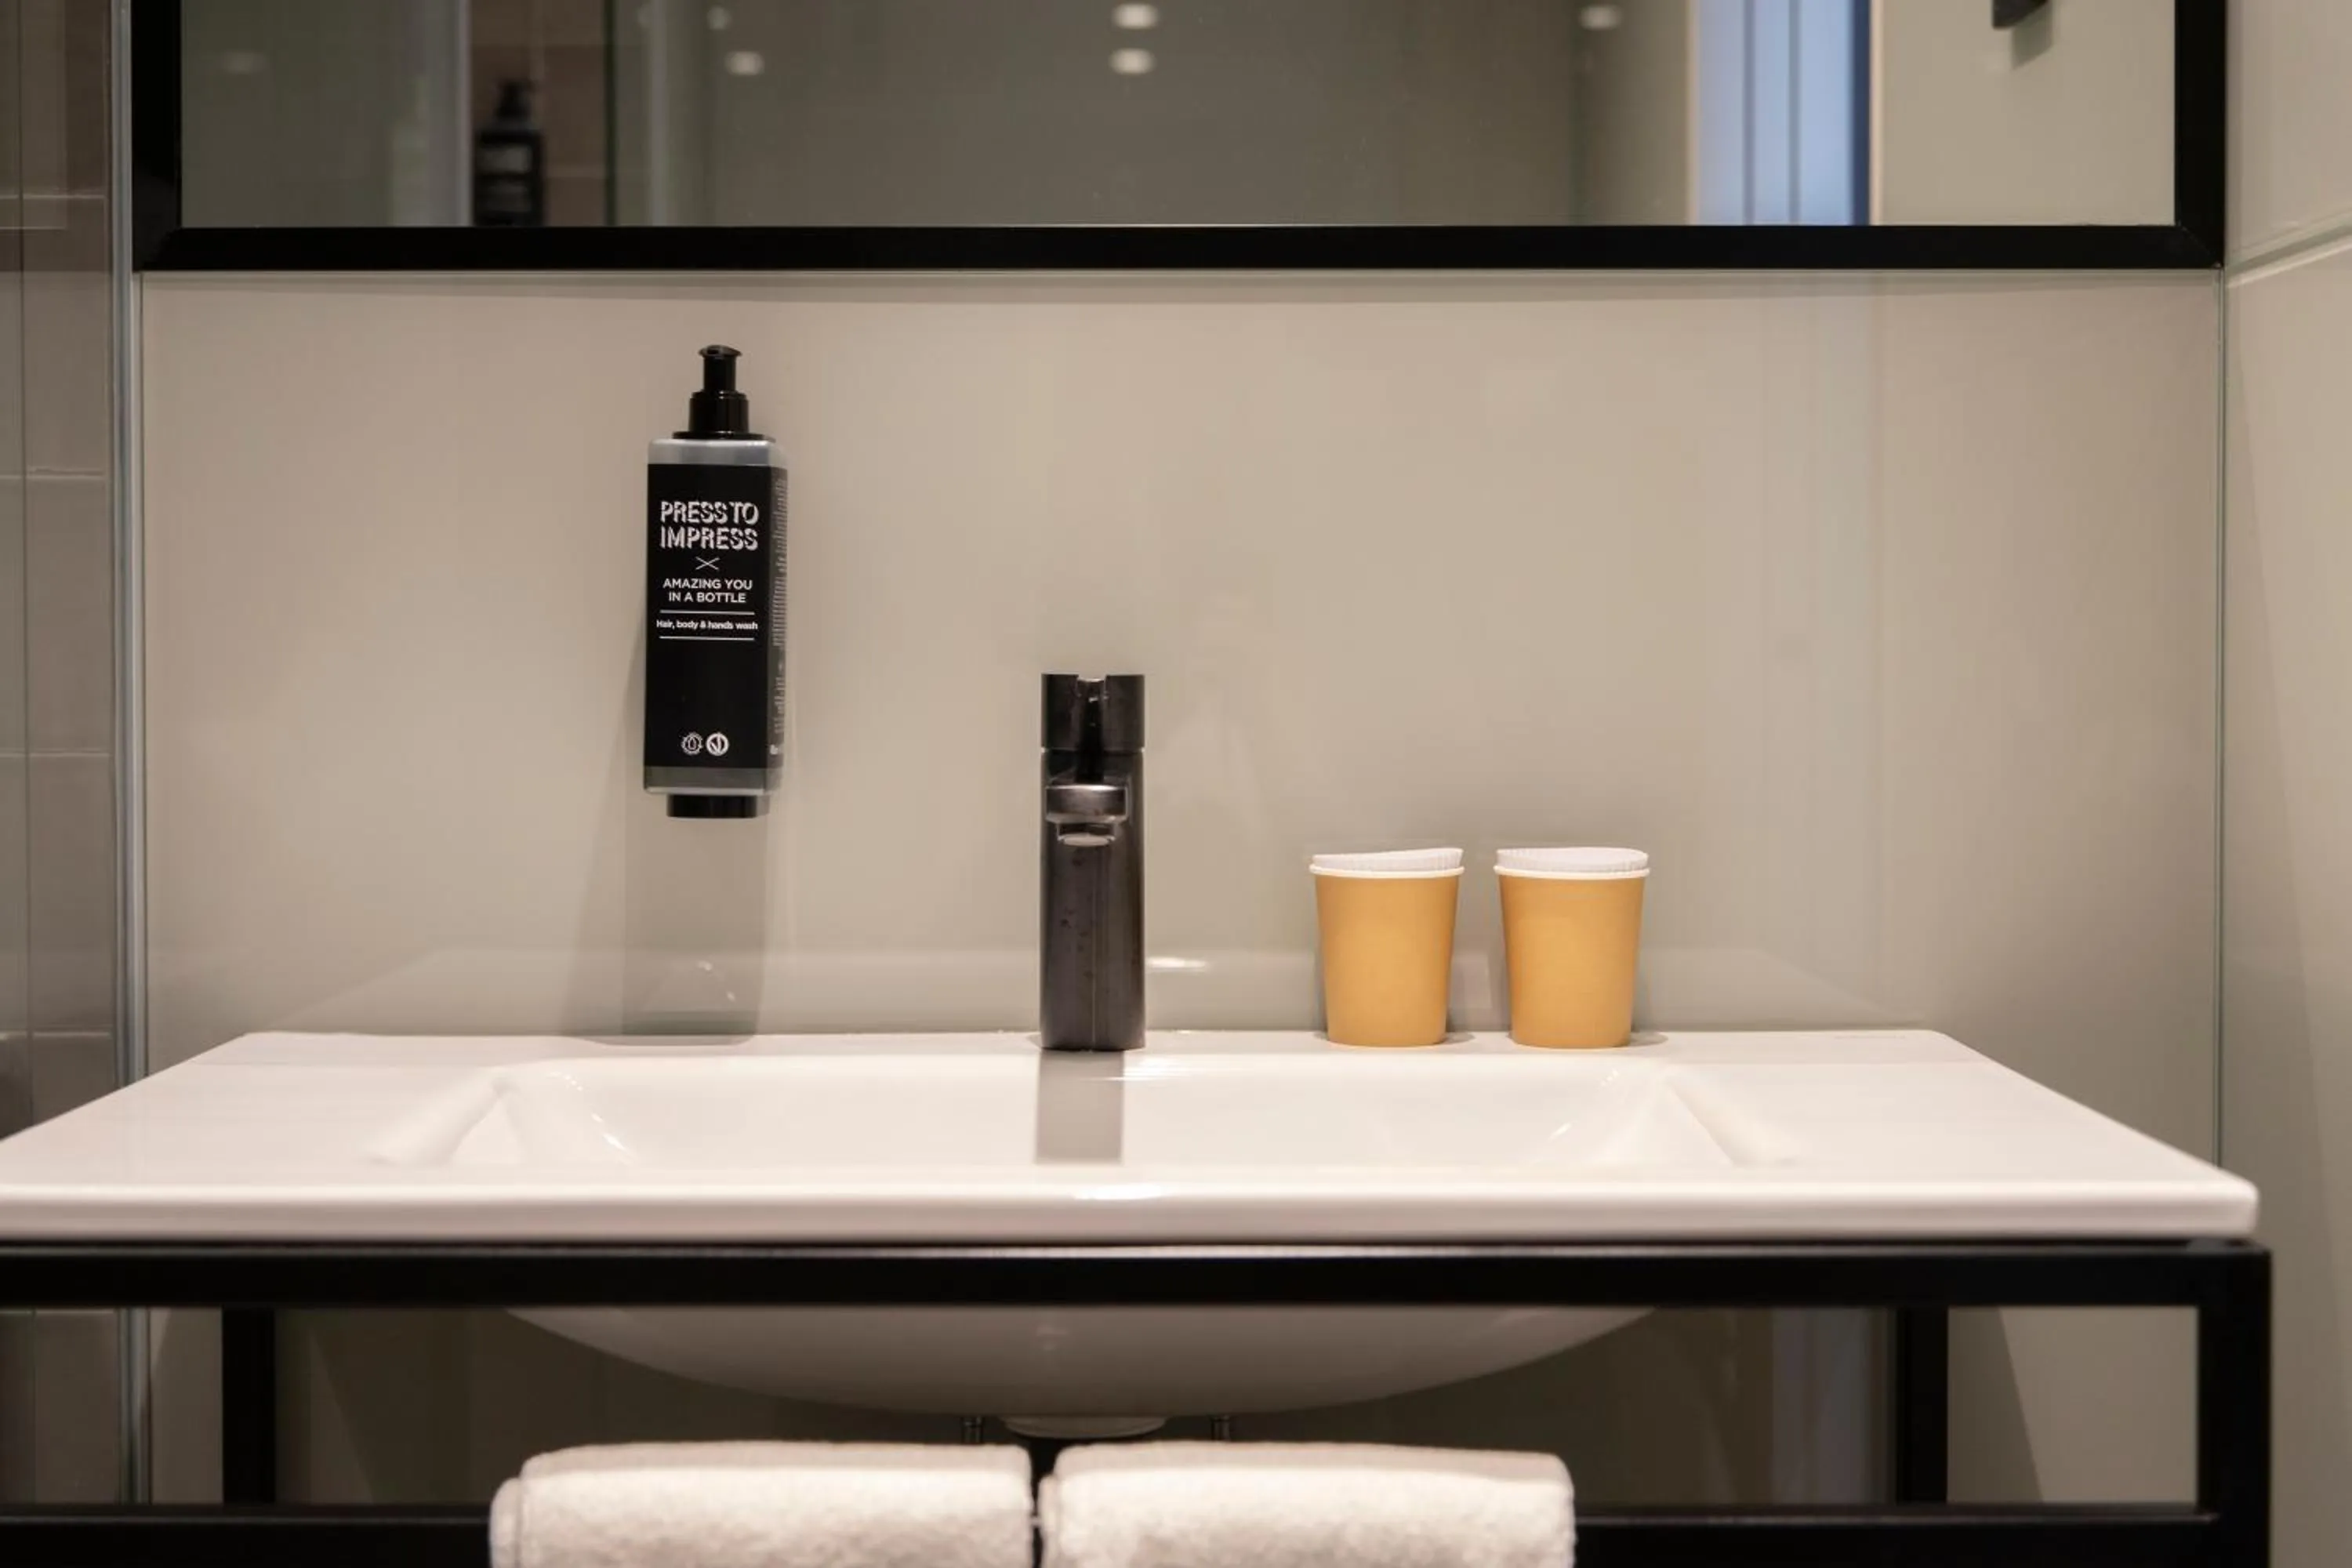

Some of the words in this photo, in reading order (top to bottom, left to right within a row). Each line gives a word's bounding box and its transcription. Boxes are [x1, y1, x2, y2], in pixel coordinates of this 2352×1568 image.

[660, 500, 728, 524] PRESS
[728, 501, 760, 525] TO
[659, 526, 759, 550] IMPRESS
[662, 578, 721, 590] AMAZING
[725, 579, 753, 590] YOU
[669, 592, 681, 602] IN
[684, 592, 693, 602] A
[697, 592, 746, 603] BOTTLE
[656, 619, 675, 630] Hair,
[677, 620, 698, 630] body
[708, 620, 733, 630] hands
[735, 620, 758, 630] wash
